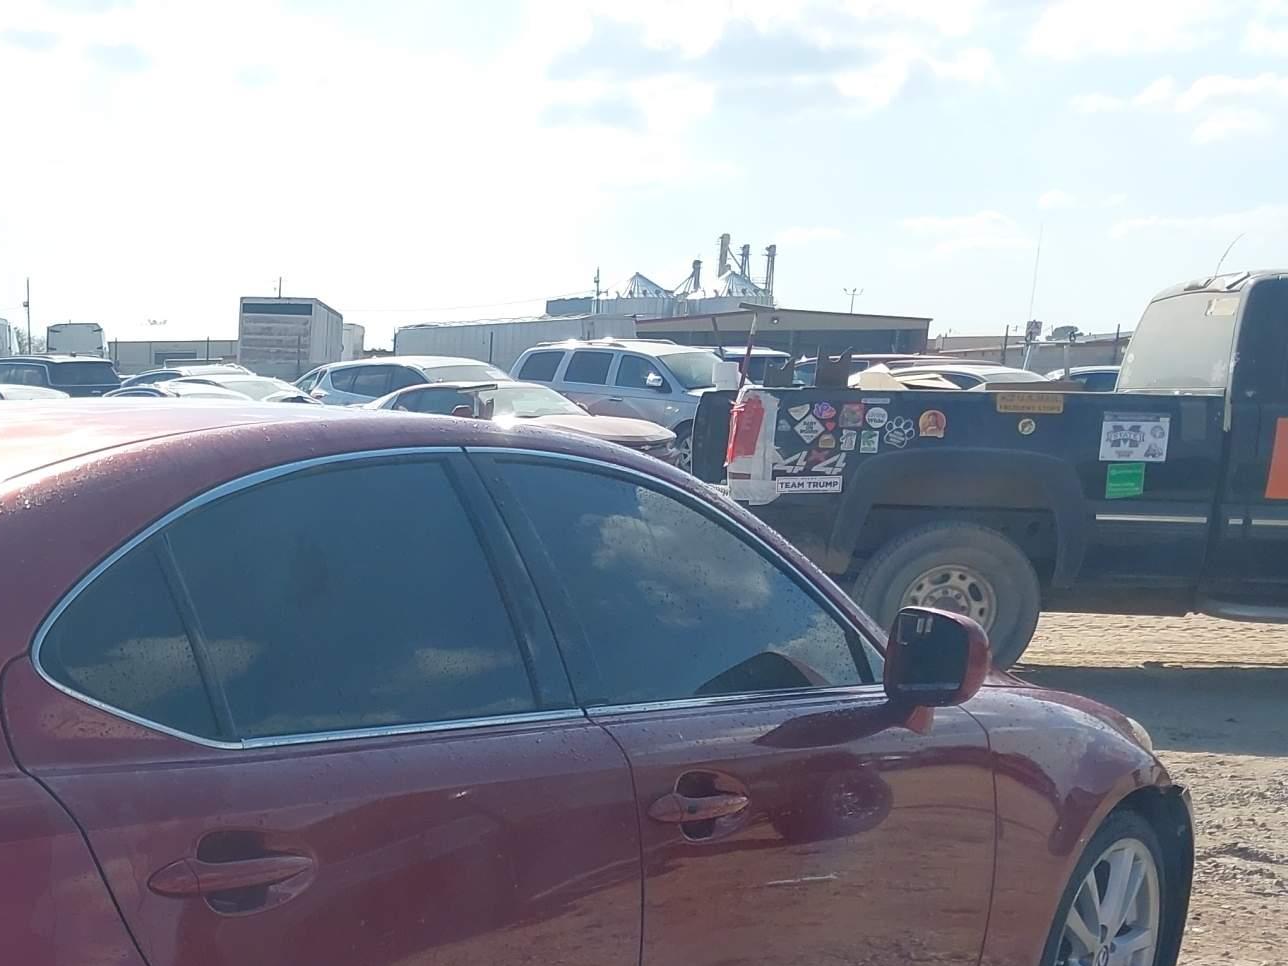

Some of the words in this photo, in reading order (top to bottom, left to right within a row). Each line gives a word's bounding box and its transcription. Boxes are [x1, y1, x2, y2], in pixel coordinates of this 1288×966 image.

[1113, 431, 1137, 439] STATE
[779, 481, 805, 489] TEAM
[807, 480, 839, 489] TRUMP
